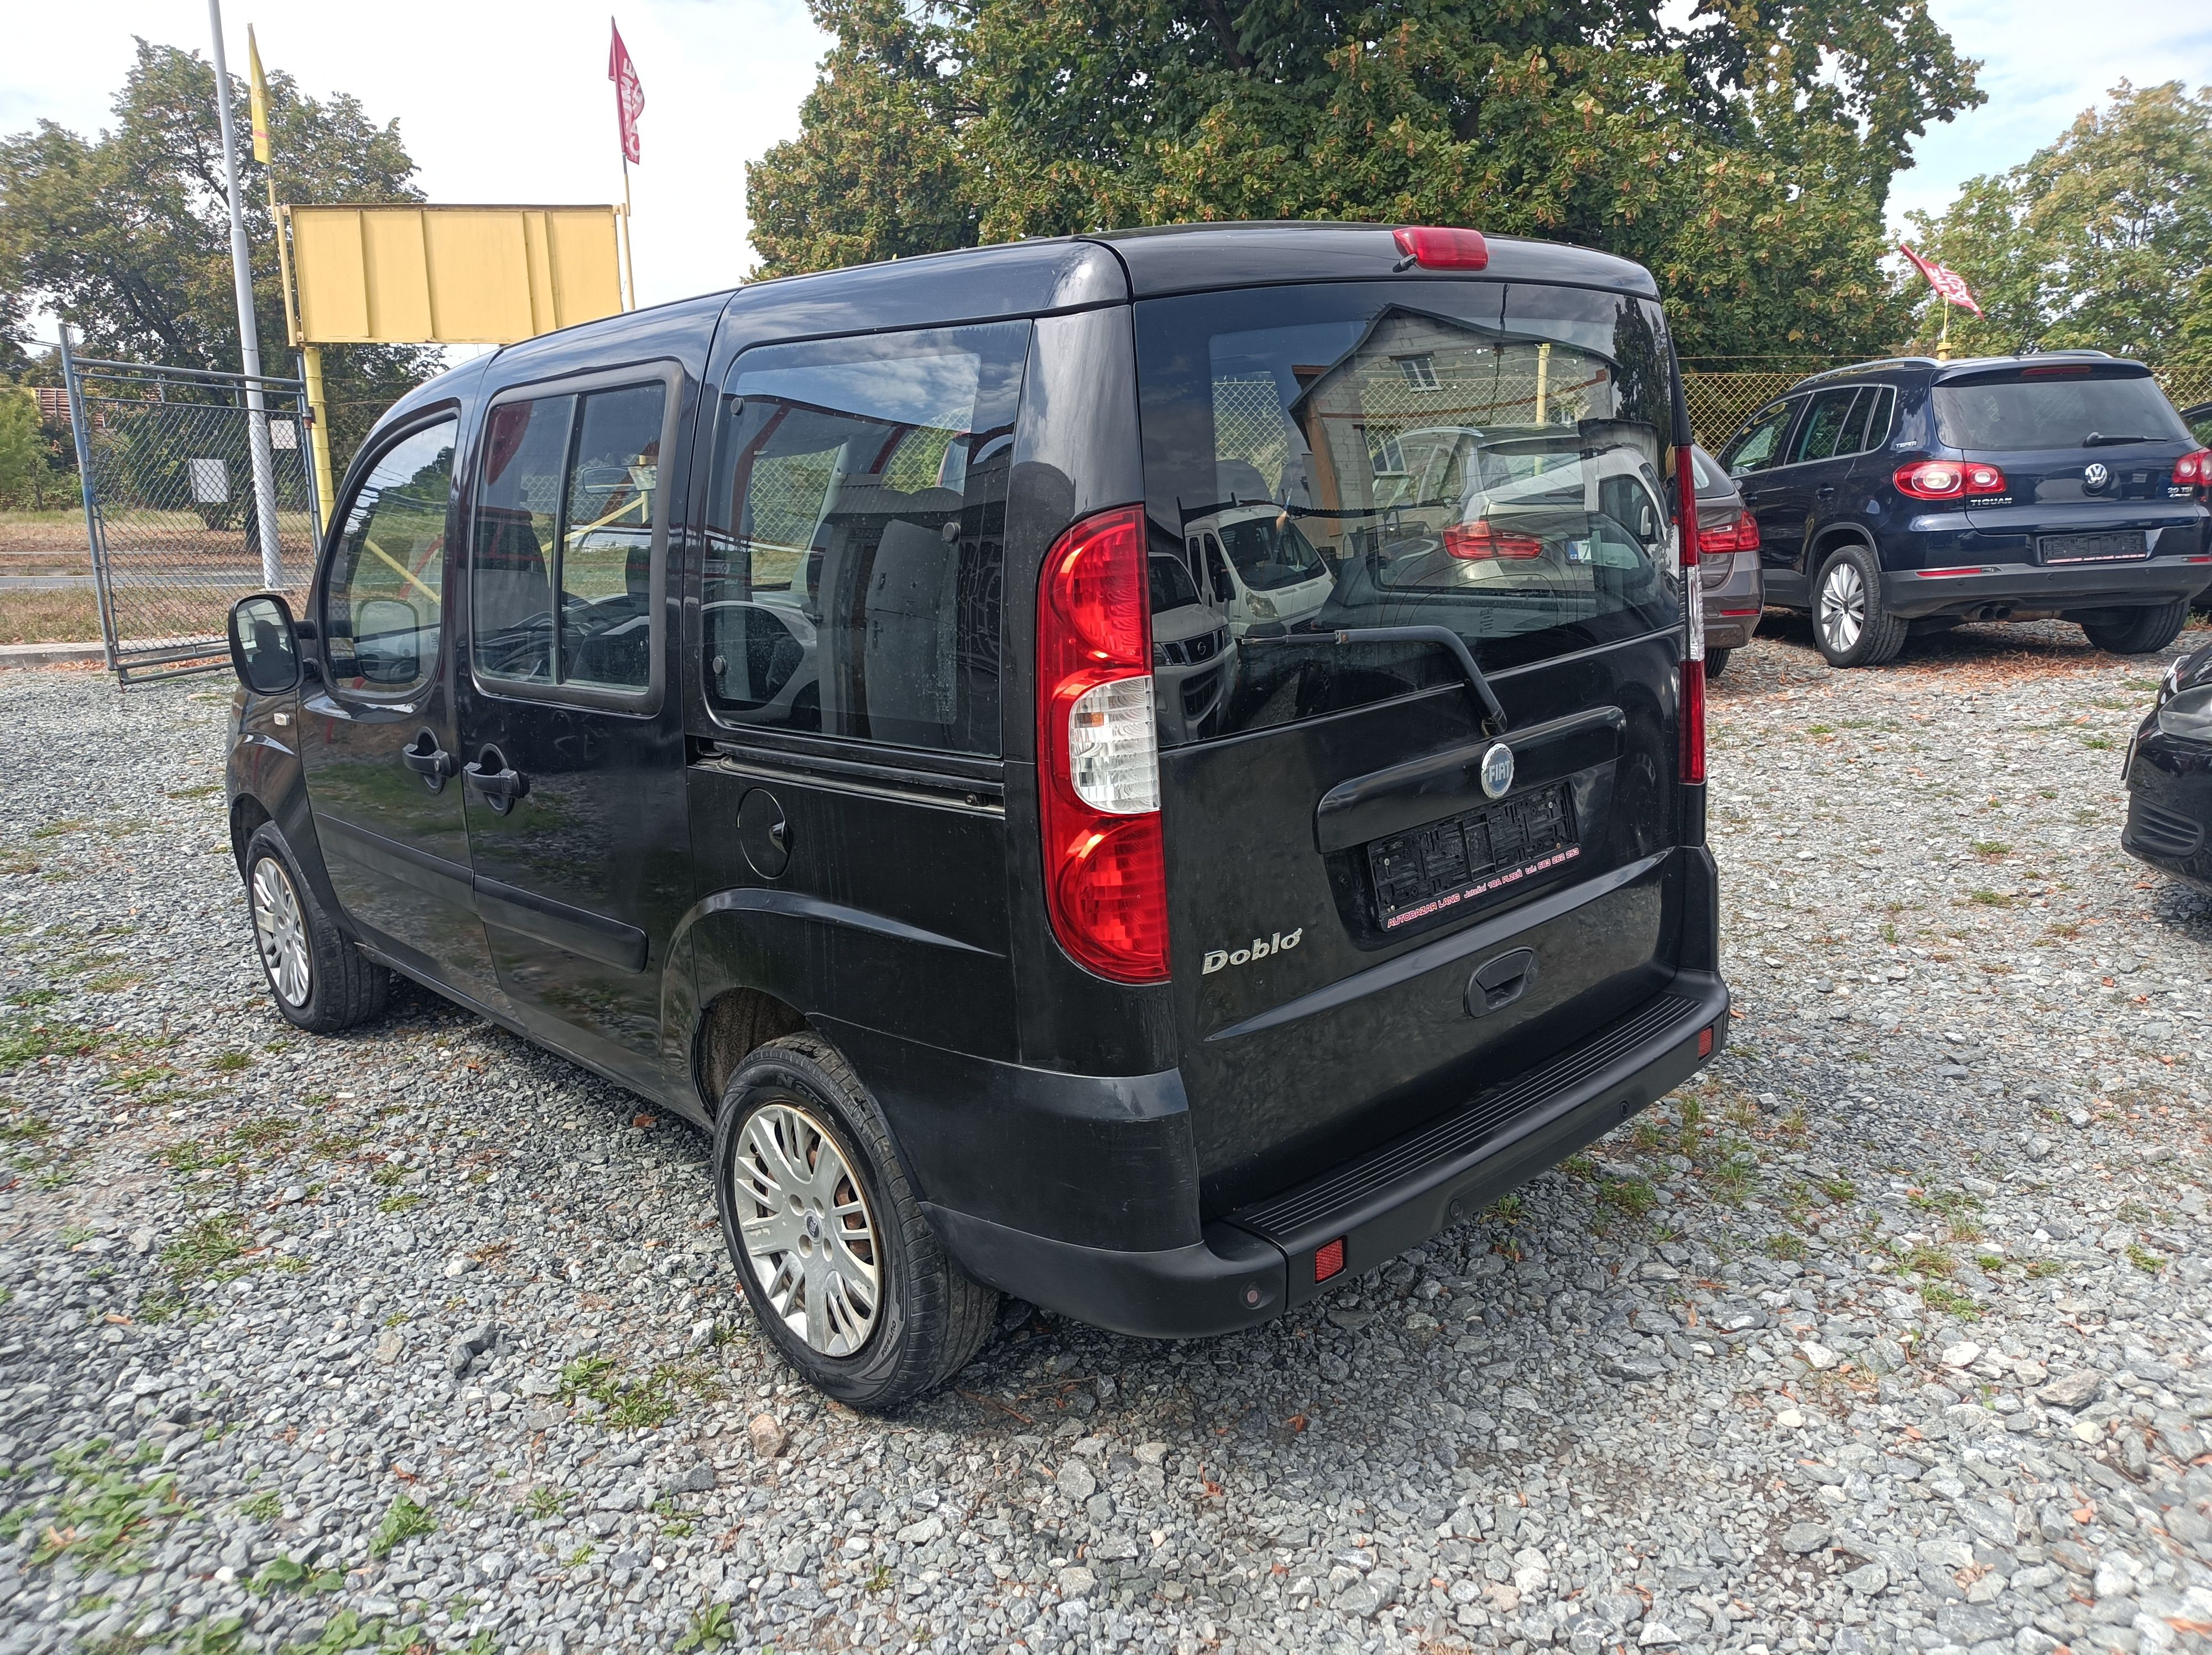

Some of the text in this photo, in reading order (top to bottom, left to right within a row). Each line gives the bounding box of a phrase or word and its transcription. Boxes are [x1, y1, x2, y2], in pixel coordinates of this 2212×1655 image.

[1970, 497, 2012, 506] TIGUAN
[1489, 760, 1510, 783] FIAT
[1387, 902, 1437, 928] AUTOBAZAR
[1438, 893, 1460, 908] LANG
[1488, 878, 1502, 889] 10A
[1502, 868, 1522, 884] PLZEŇ
[1551, 853, 1566, 865] 262
[1566, 847, 1579, 860] 253
